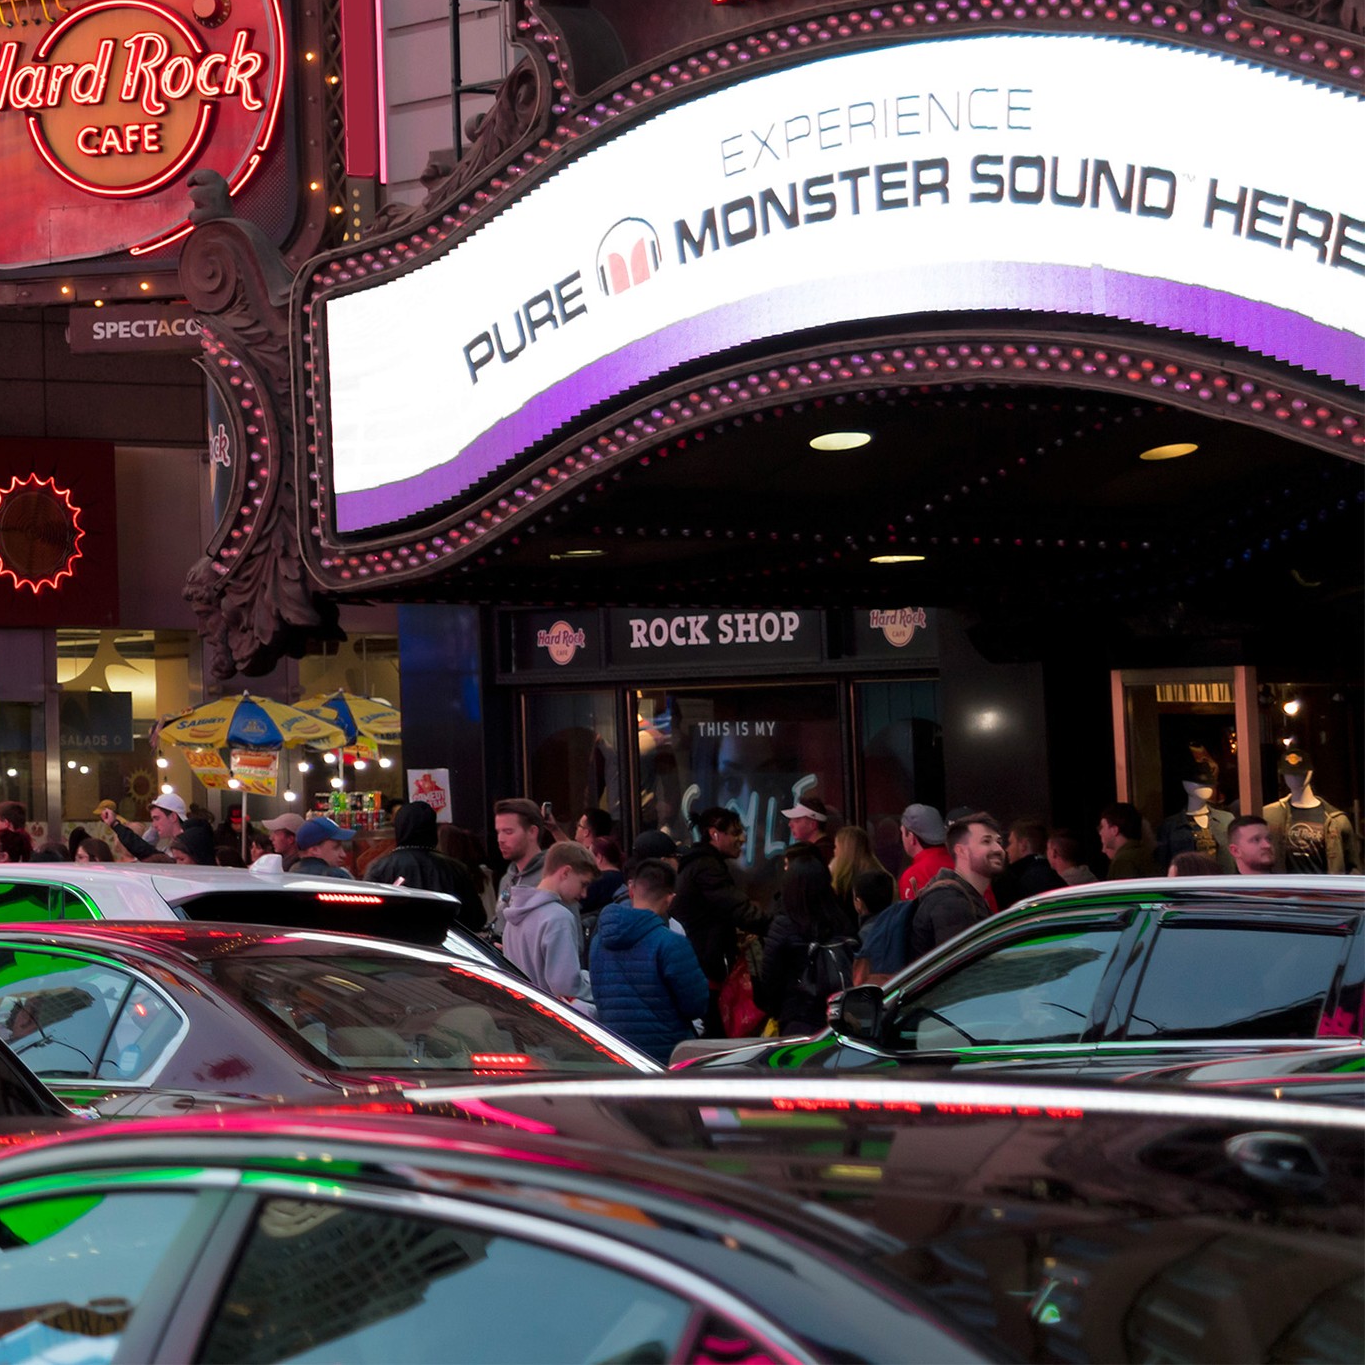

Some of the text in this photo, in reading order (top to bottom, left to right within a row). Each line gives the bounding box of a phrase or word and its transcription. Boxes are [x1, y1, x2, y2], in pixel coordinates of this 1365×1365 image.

[123, 30, 265, 118] Rock
[77, 123, 163, 158] CAFE
[719, 87, 1035, 178] EXPERIENCE
[462, 154, 1365, 386] PURE MONSTER SOUND HERE
[630, 610, 801, 650] ROCK SHOP
[869, 606, 927, 630] Hard Rock
[537, 628, 586, 649] Hard Rock
[892, 630, 906, 639] CAFE
[555, 649, 568, 657] CAFE
[697, 720, 777, 738] THIS IS MY
